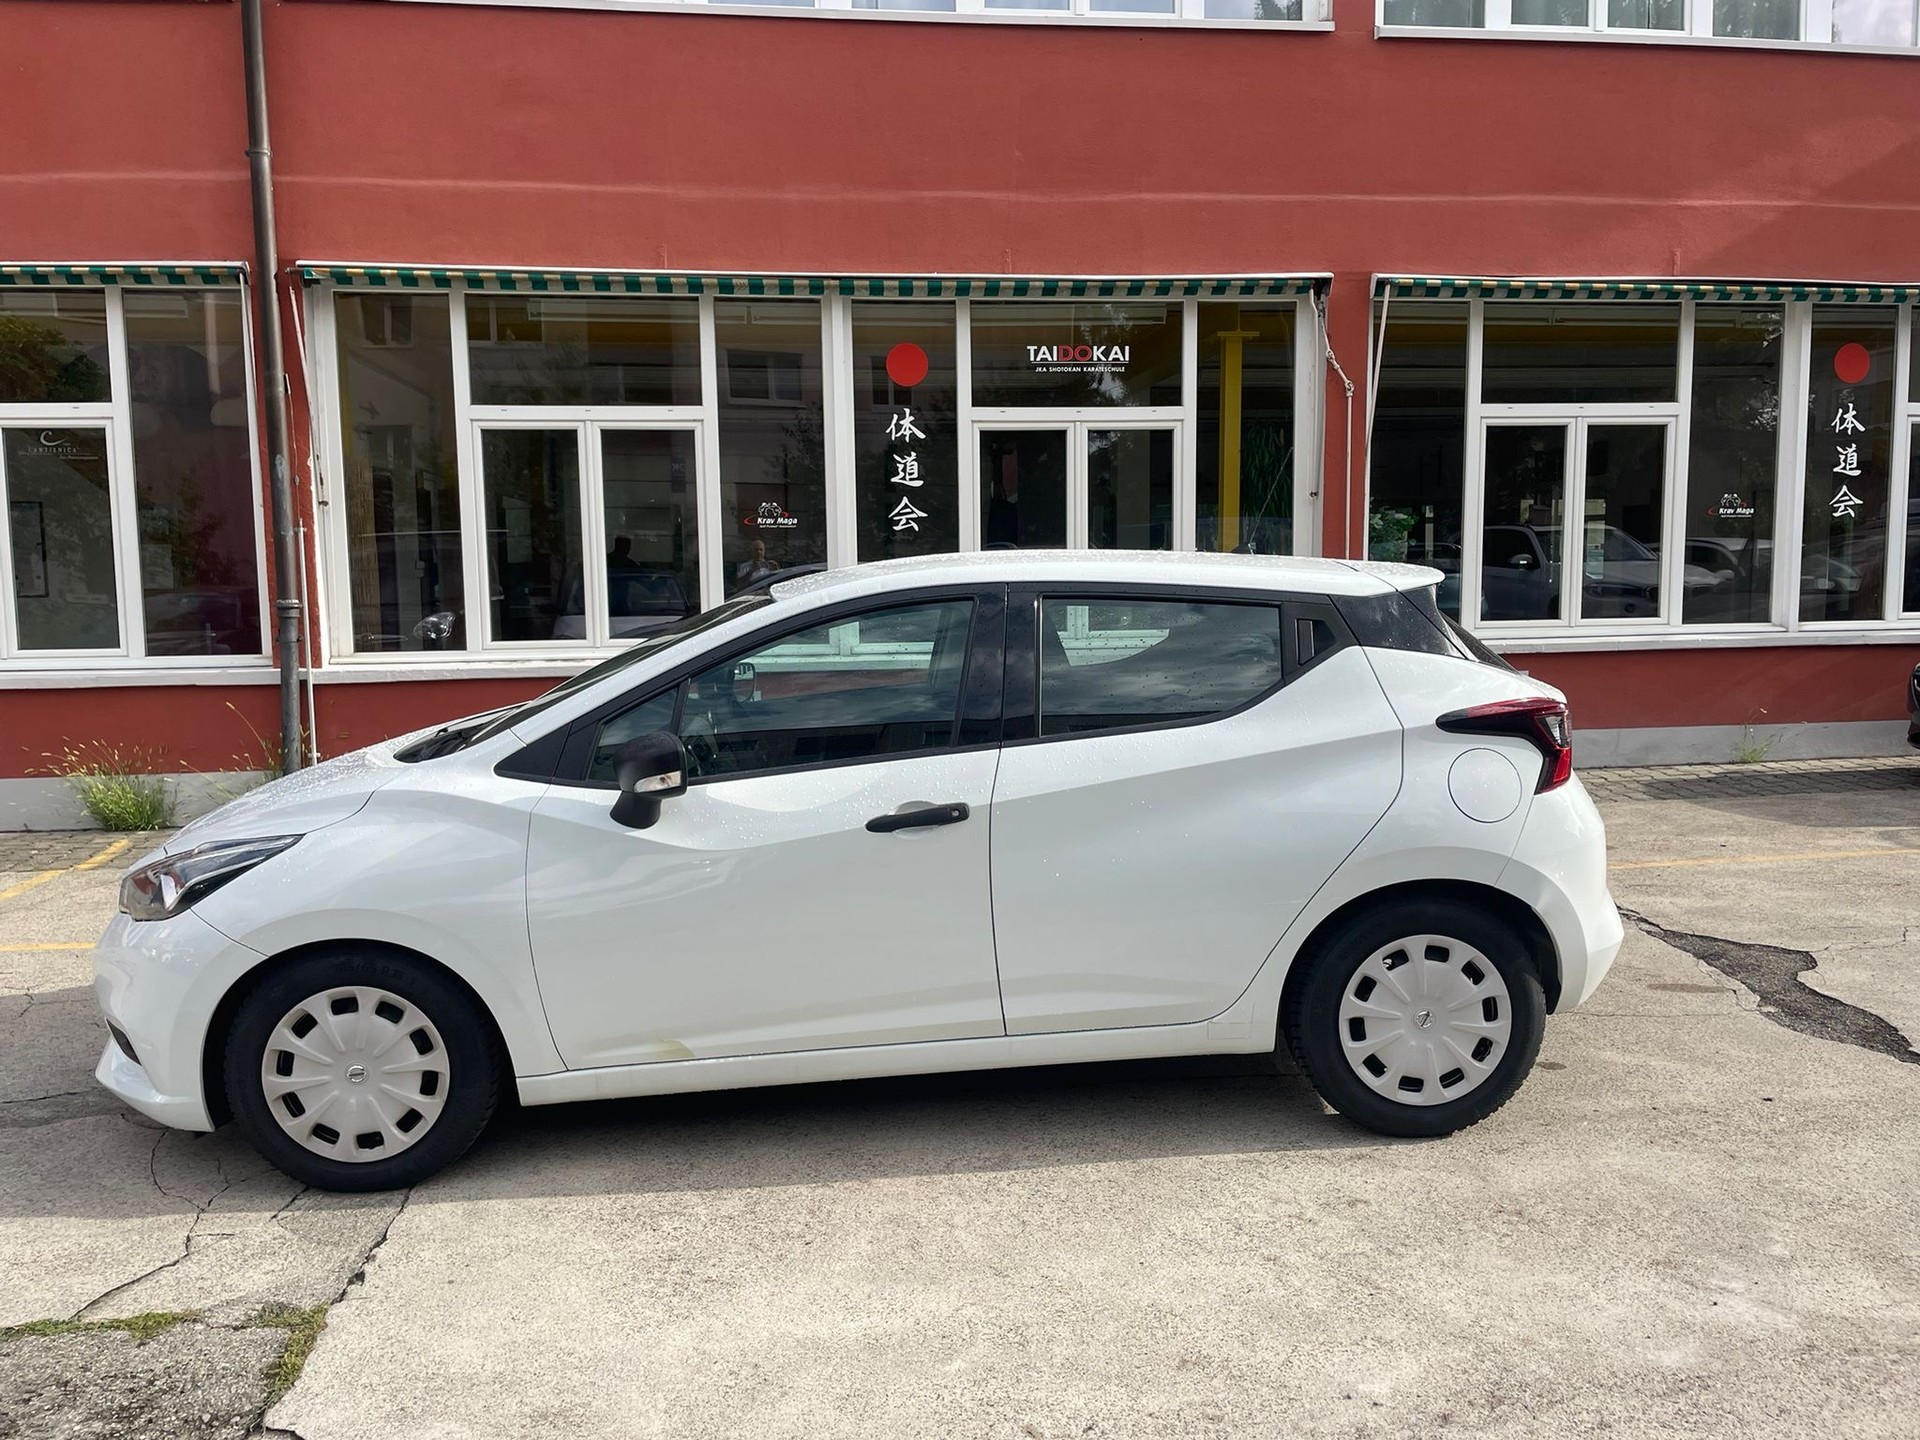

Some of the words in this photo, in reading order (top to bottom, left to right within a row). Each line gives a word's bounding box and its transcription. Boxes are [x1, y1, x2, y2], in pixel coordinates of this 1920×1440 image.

[1026, 345, 1130, 362] TAIDOKAI
[885, 408, 929, 532] 体道会
[1829, 403, 1866, 517] 体道会
[757, 517, 776, 525] Krav
[776, 517, 798, 526] Maga
